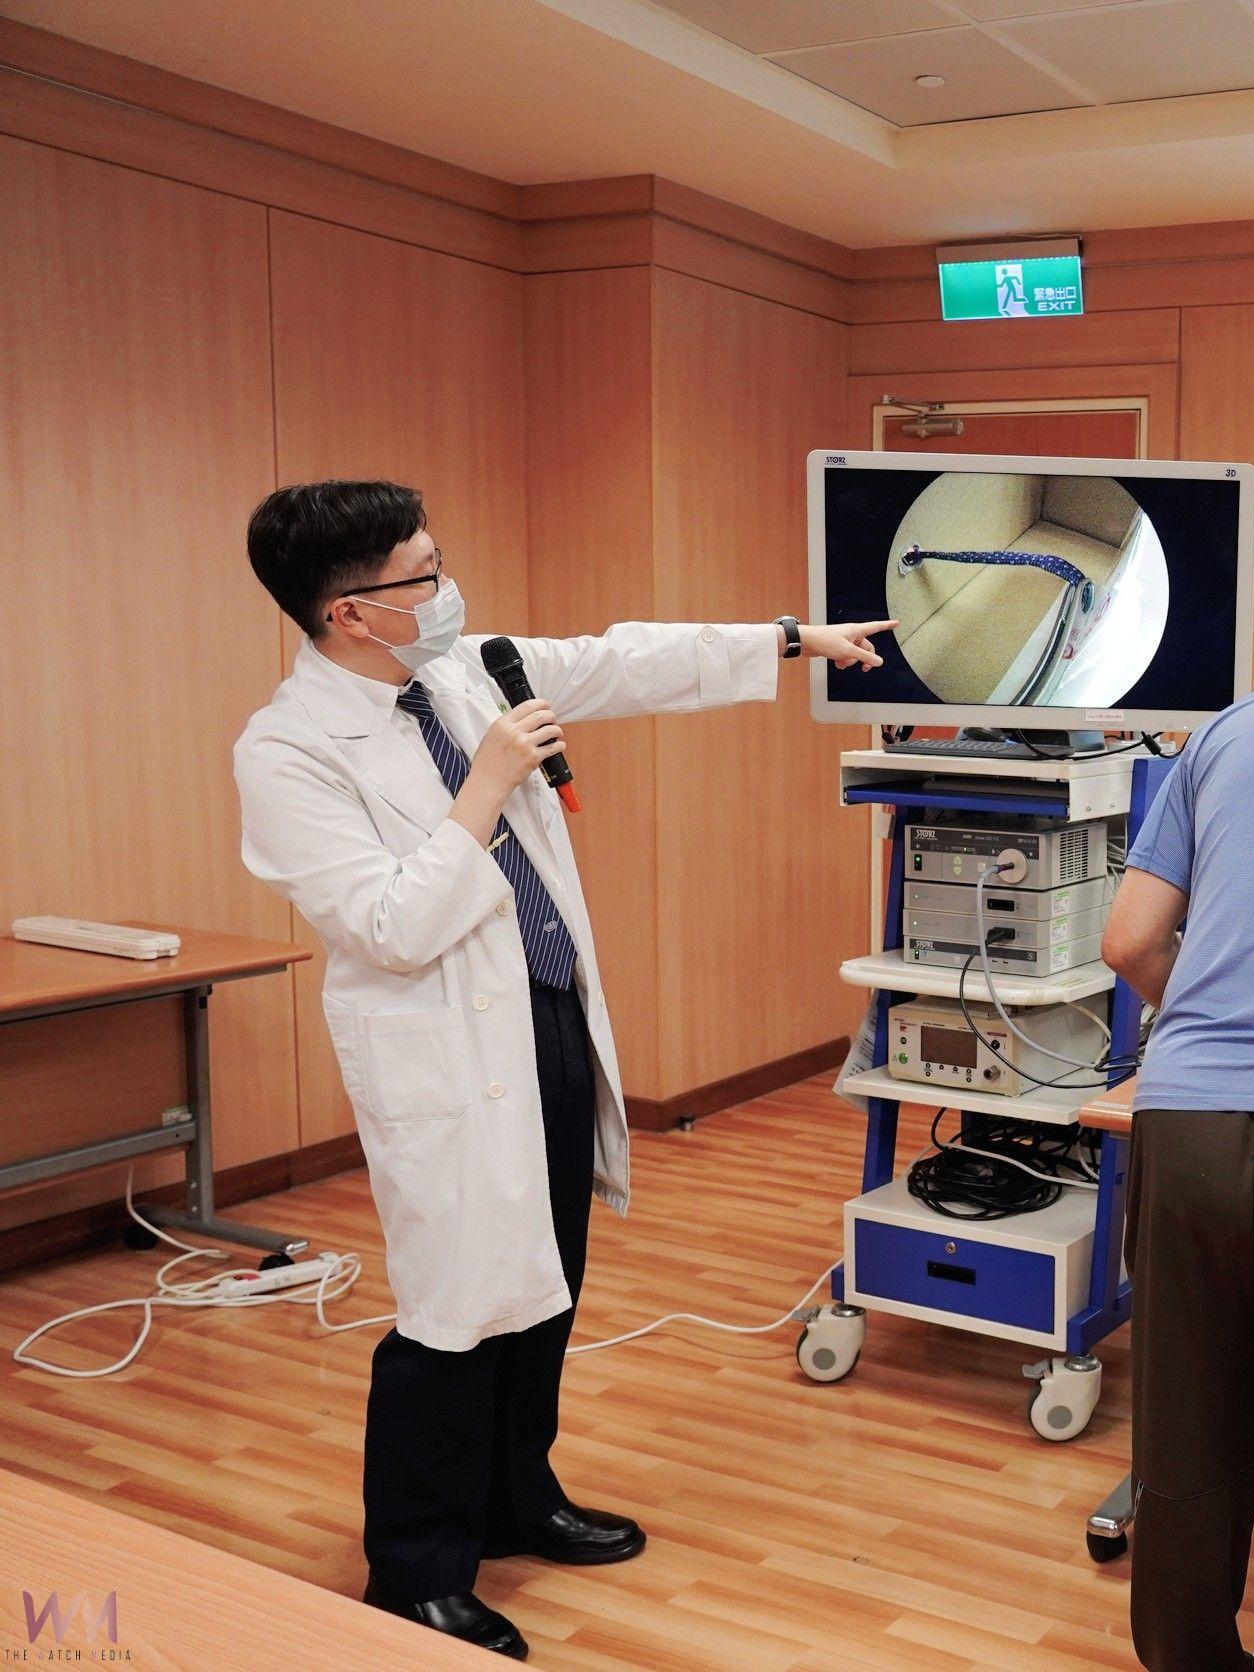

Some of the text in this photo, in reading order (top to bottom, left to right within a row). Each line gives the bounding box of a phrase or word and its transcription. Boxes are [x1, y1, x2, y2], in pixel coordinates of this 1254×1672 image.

[1034, 286, 1077, 301] 緊急出口
[1037, 301, 1076, 312] EXIT
[826, 456, 846, 464] STORZ
[1225, 469, 1237, 477] 3D
[915, 829, 936, 838] STORZ
[915, 940, 934, 948] STORZ
